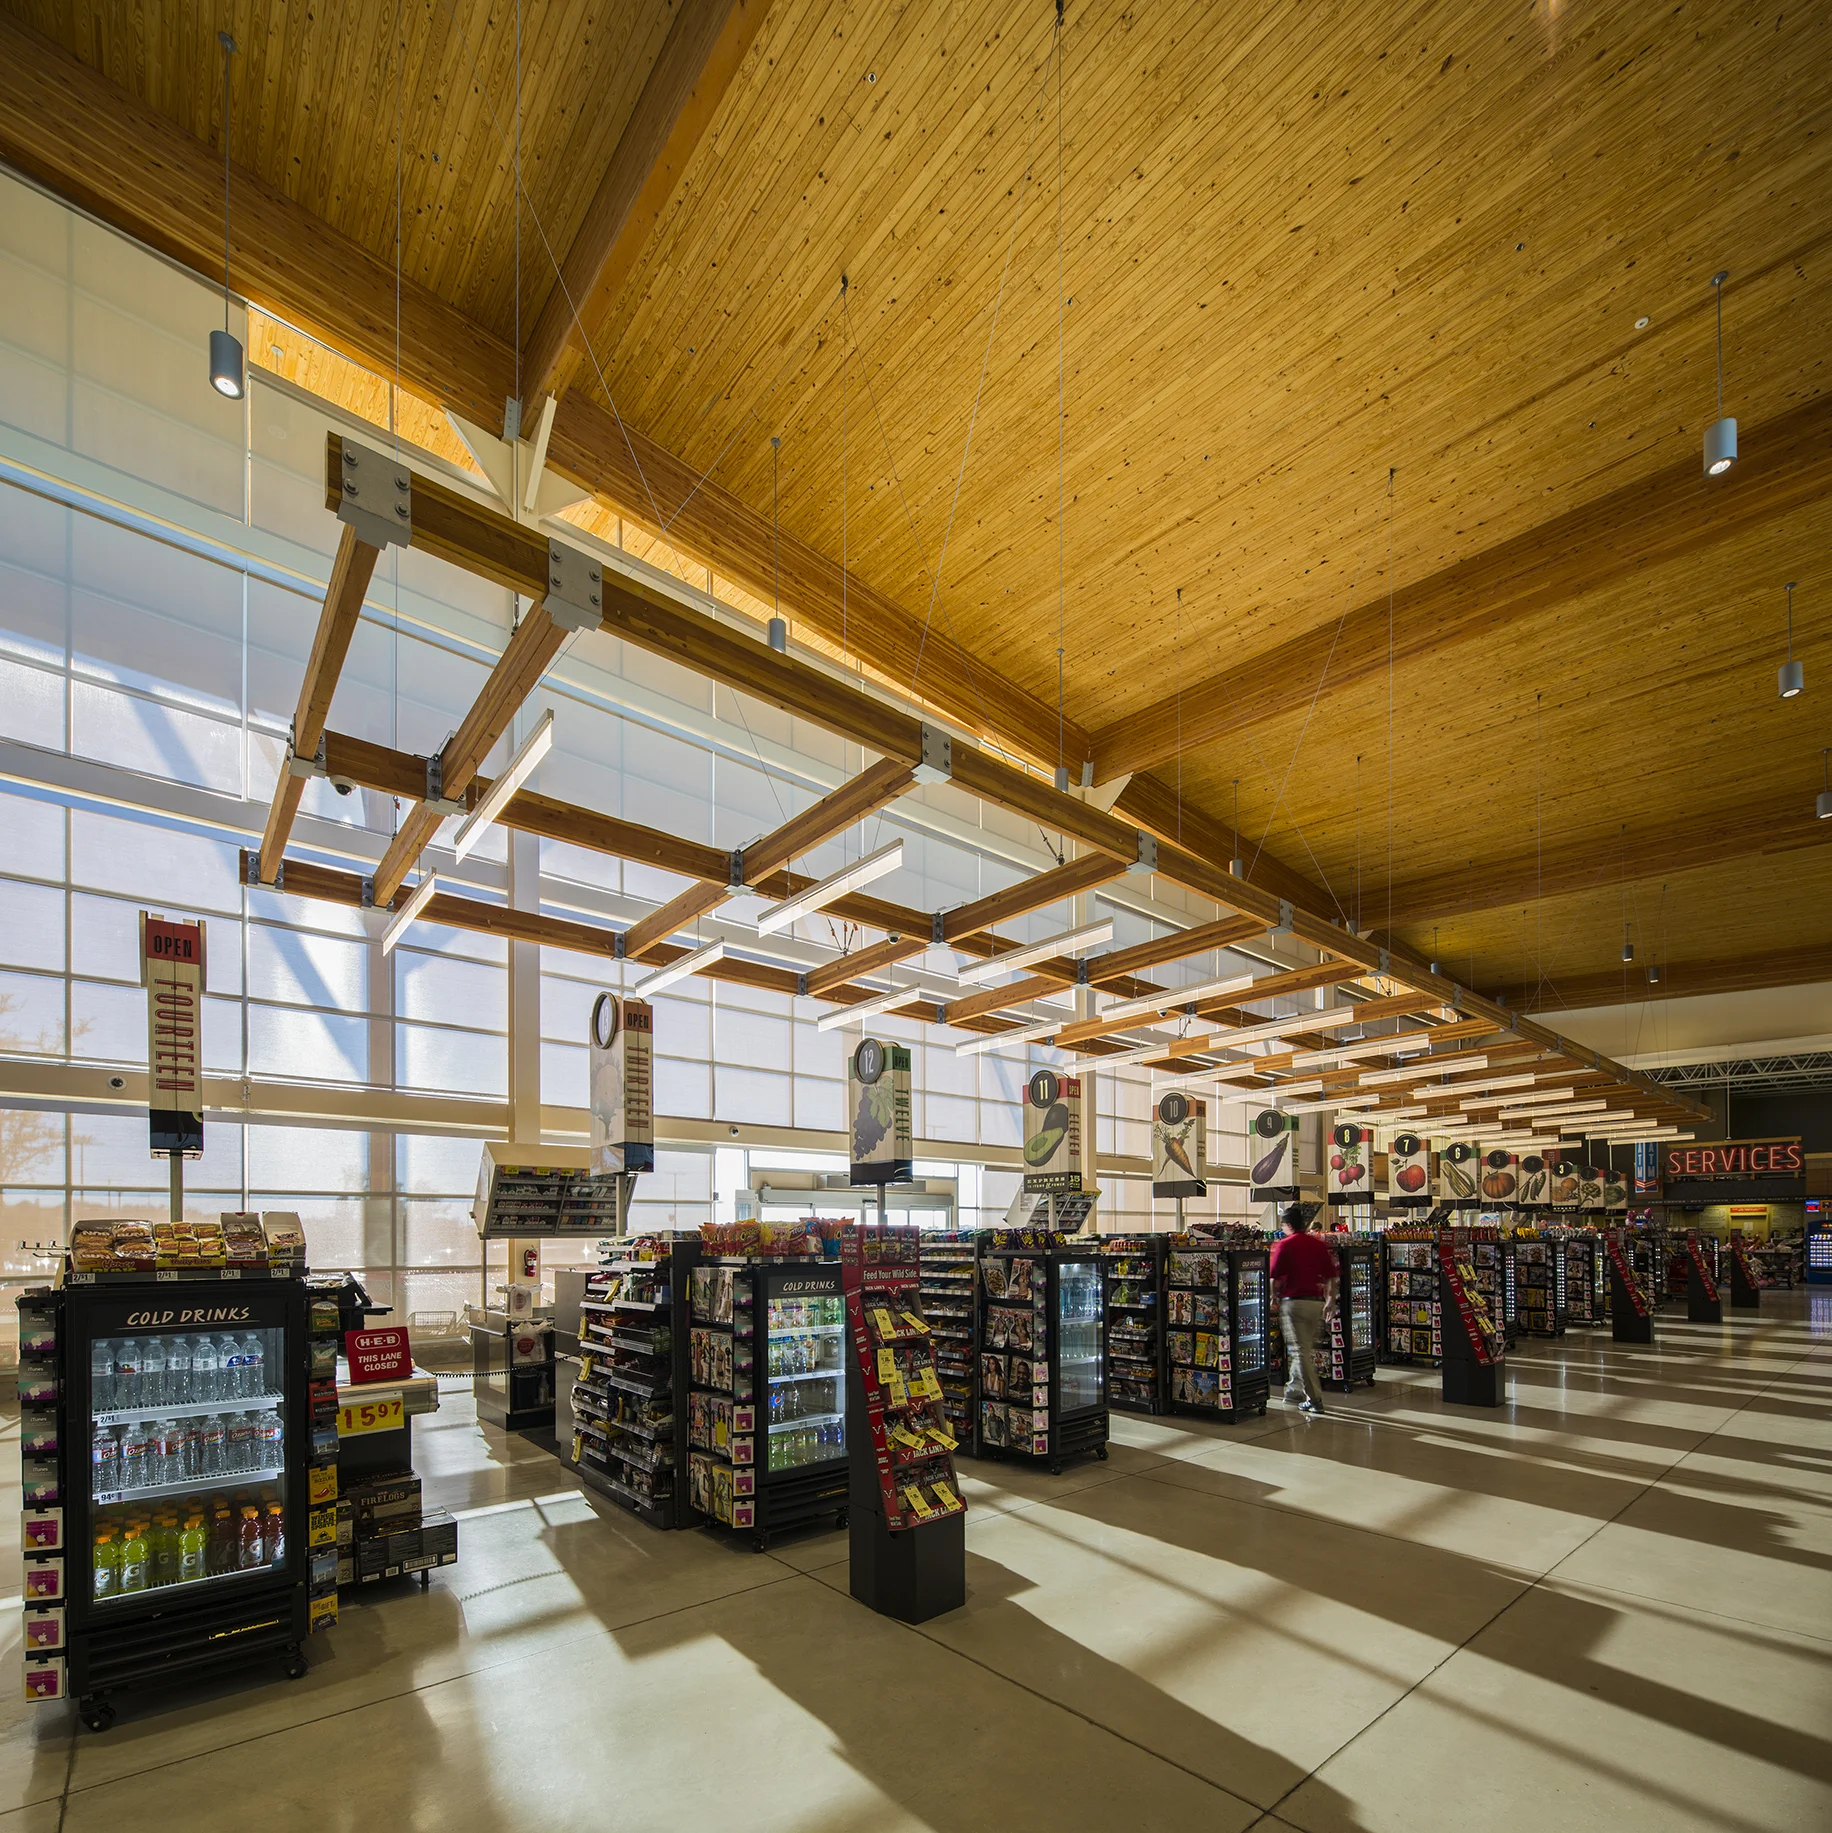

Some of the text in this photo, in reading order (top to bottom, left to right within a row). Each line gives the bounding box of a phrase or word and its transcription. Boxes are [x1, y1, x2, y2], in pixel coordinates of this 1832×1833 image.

[153, 934, 193, 959] OPEN
[600, 1006, 610, 1038] 13
[627, 1012, 649, 1029] OPEN
[154, 978, 195, 1092] FOURTEEN
[864, 1049, 874, 1074] 12
[626, 1045, 649, 1129] THIRTEEN
[1039, 1079, 1049, 1101] 11
[1068, 1085, 1080, 1095] OPEN
[895, 1089, 910, 1142] TWELVE
[1168, 1101, 1178, 1118] 10
[1266, 1117, 1273, 1129] 9
[1069, 1113, 1080, 1156] ELEVEN
[1344, 1129, 1350, 1143] 8
[1197, 1140, 1206, 1158] TEN
[1403, 1139, 1410, 1152] 7
[1454, 1147, 1461, 1159] 6
[1495, 1154, 1501, 1165] 5
[1668, 1143, 1803, 1175] SERVICES
[1559, 1164, 1564, 1174] 3
[1027, 1176, 1065, 1184] EXPRESS
[1069, 1175, 1081, 1183] 15
[863, 1268, 918, 1280] Feed Your Wild Side.
[782, 1280, 836, 1292] COLD DRINKS
[126, 1306, 250, 1326] COLD DRINKS
[357, 1351, 402, 1364] THIS LANE
[364, 1360, 398, 1372] CLOSED
[100, 1415, 115, 1423] 2/$1
[913, 1447, 928, 1458] JACK
[361, 1491, 405, 1506] FIRELOGS
[183, 1553, 196, 1566] G
